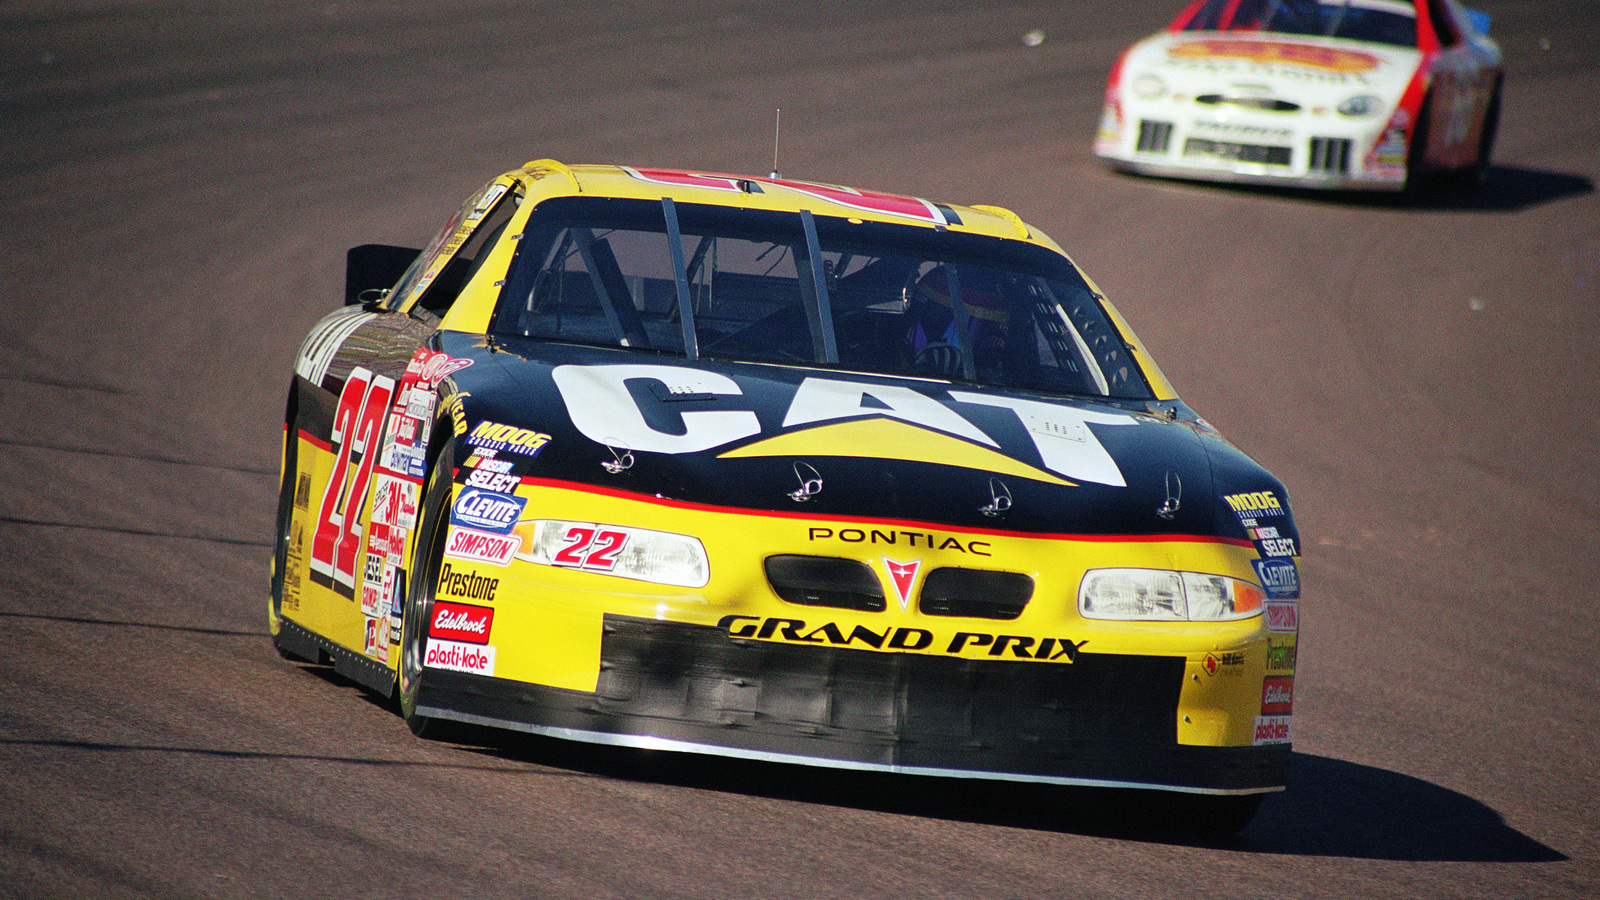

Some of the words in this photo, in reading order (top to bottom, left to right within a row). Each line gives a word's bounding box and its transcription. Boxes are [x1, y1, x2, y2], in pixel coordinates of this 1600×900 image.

[470, 421, 552, 449] MOOG
[551, 364, 1139, 487] CAT
[468, 436, 506, 450] CHASSIS
[508, 444, 537, 456] PARTS
[310, 366, 395, 590] 22
[477, 457, 513, 474] NASCAR
[465, 470, 521, 493] SELECT
[385, 481, 402, 526] 3M
[456, 489, 522, 523] CLEVITE
[1223, 491, 1281, 512] MOOG
[449, 531, 514, 560] SIMPSON
[551, 526, 630, 571] 22
[808, 528, 992, 557] PONTIAC
[1261, 538, 1298, 558] SELECT
[437, 563, 500, 601] Prestone
[1258, 561, 1298, 587] CLEVITE
[434, 609, 487, 635] Edelbrock
[717, 615, 934, 651] GRAND
[946, 632, 1091, 661] PRIX
[426, 643, 488, 670] plasti-kote
